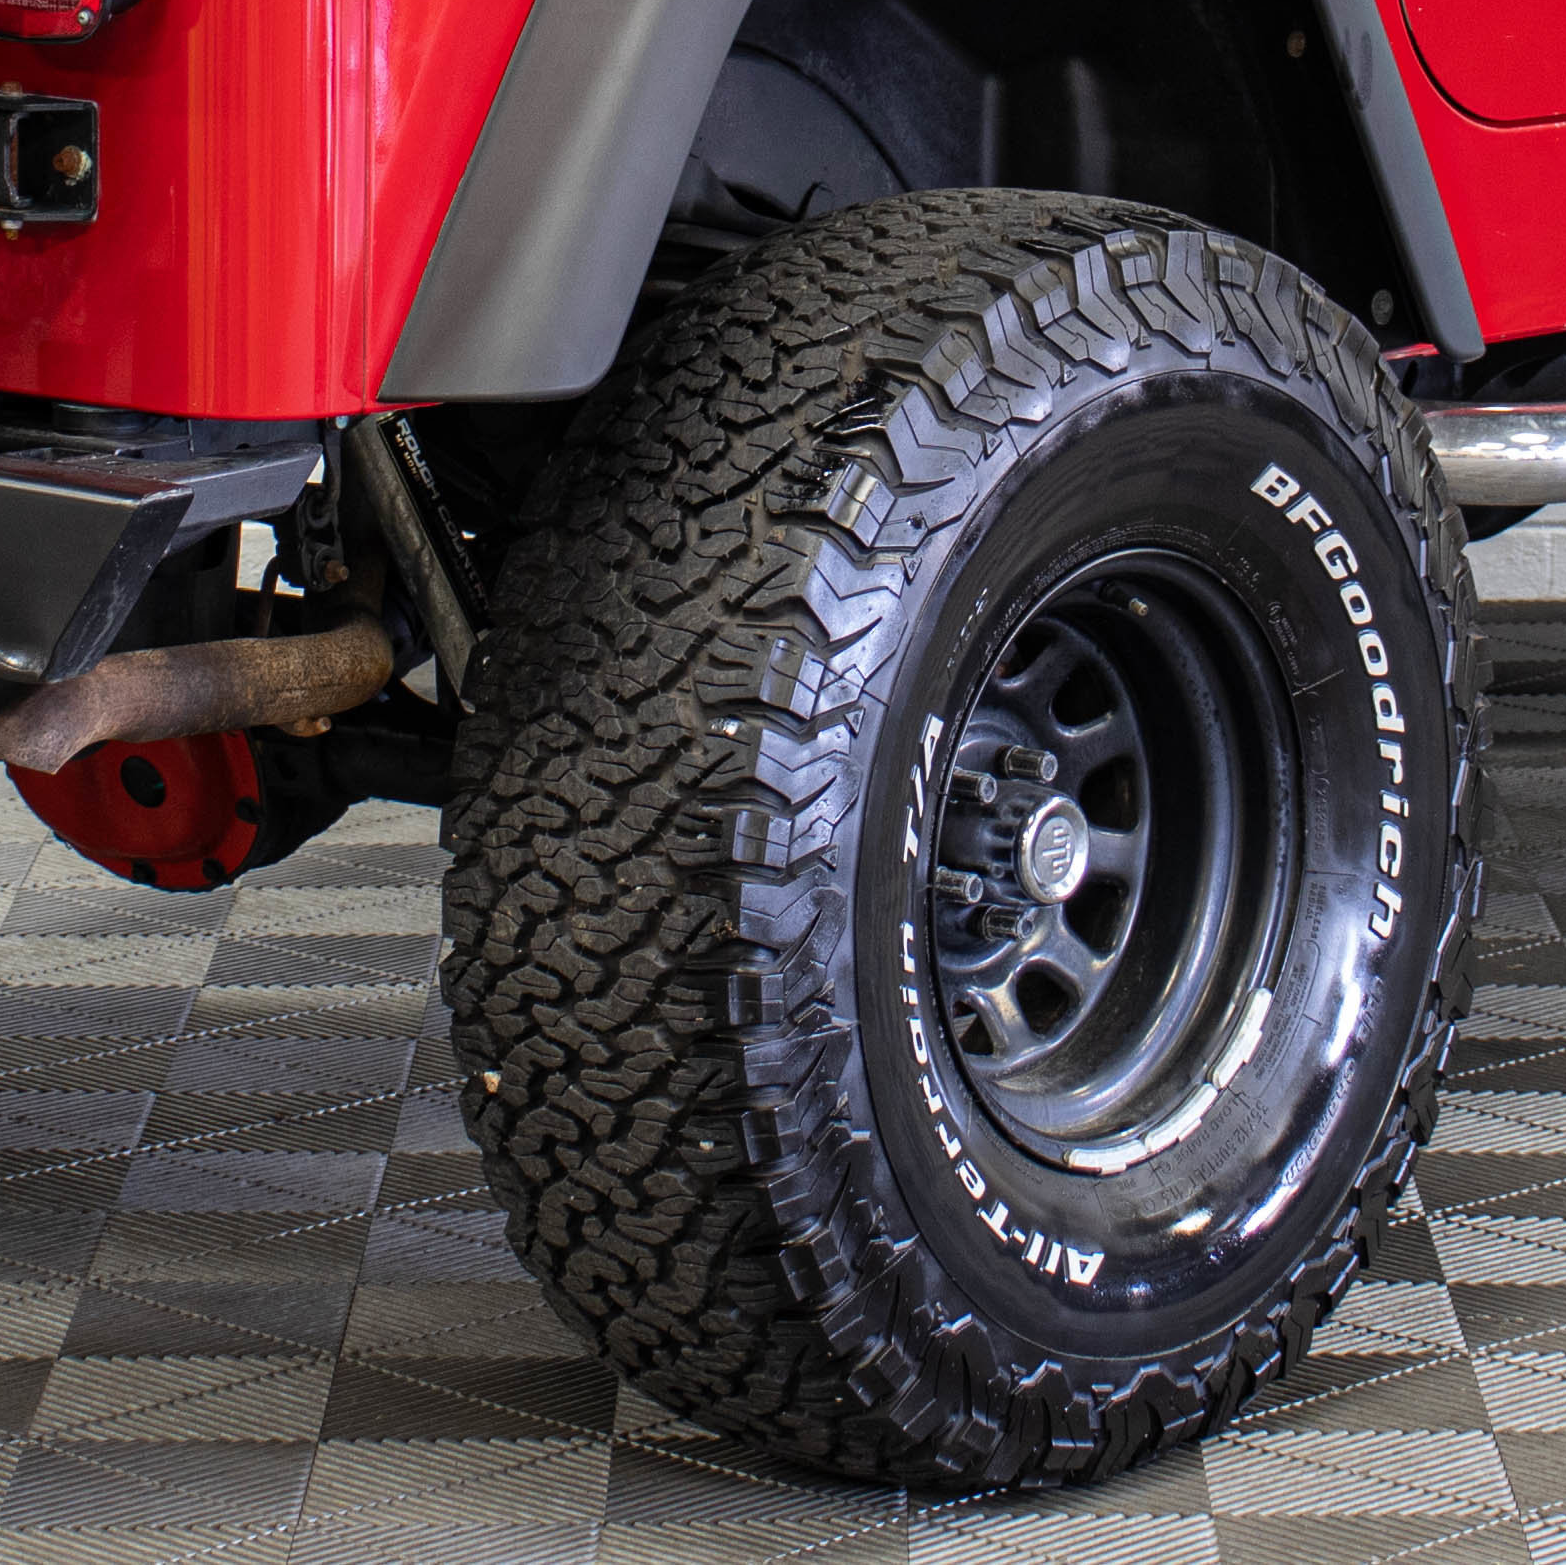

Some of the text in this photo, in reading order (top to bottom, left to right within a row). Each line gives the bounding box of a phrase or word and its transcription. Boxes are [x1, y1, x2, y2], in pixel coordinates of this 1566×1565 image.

[396, 417, 441, 500] ROUGH
[1250, 462, 1408, 939] BFGoodrich
[900, 712, 1105, 1286] All-Terrain T/A
